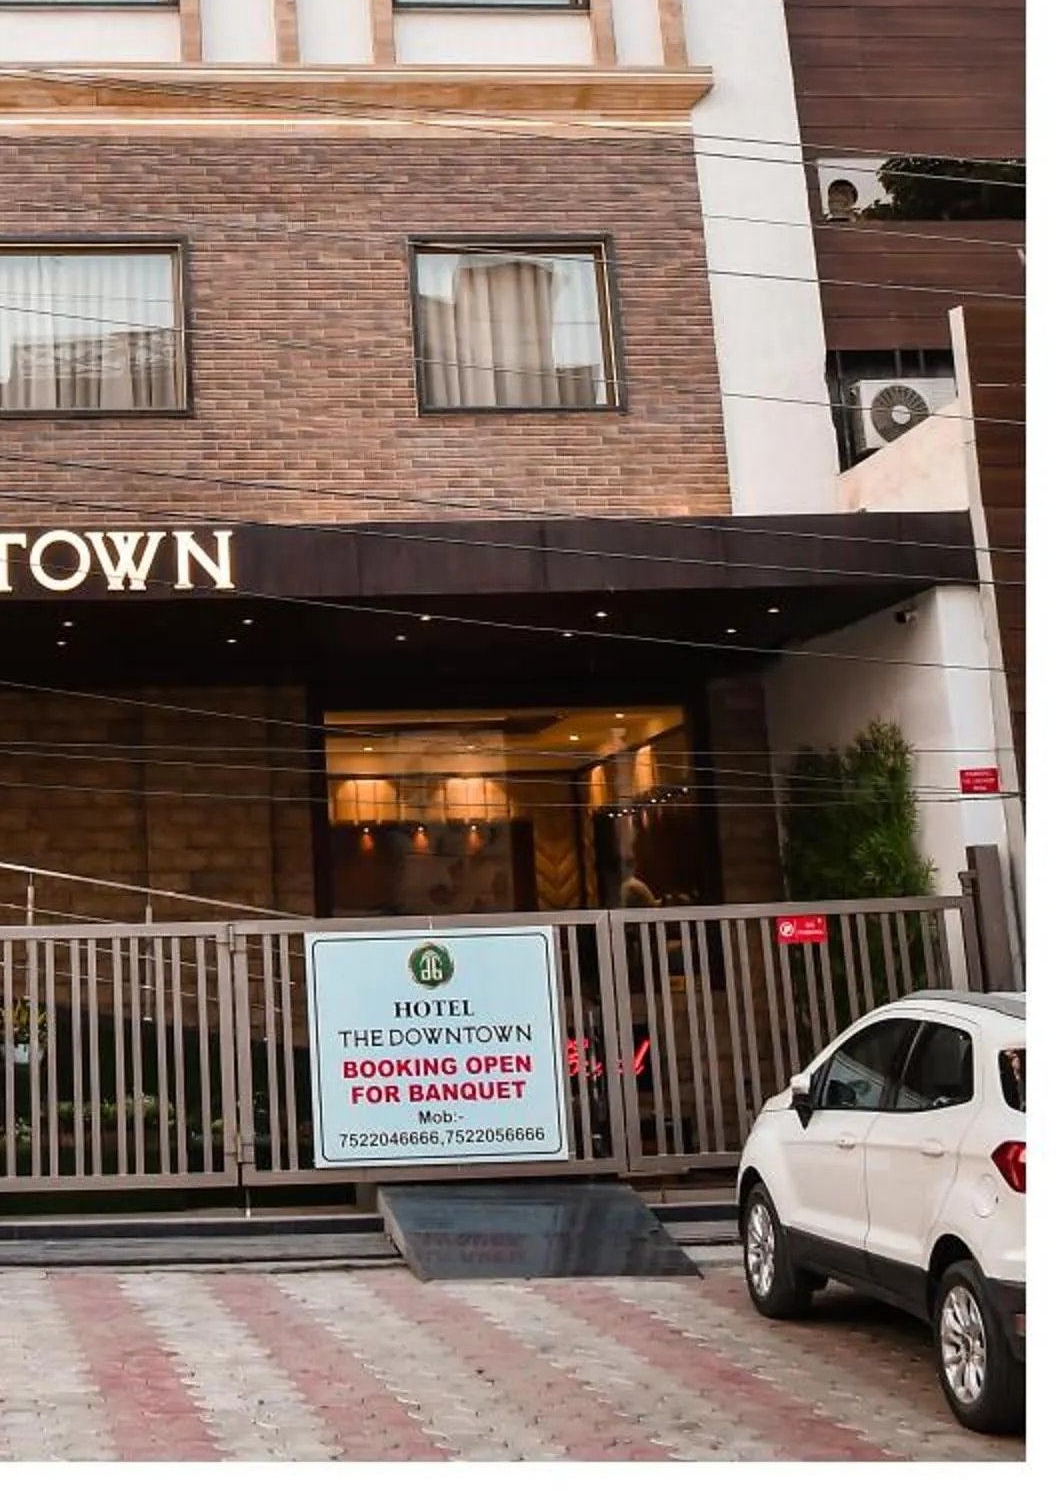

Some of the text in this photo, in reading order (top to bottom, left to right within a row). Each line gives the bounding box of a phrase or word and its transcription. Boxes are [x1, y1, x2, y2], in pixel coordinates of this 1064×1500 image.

[393, 1000, 475, 1018] HOTEL
[338, 1024, 533, 1048] THE DOWNTOWN
[343, 1054, 532, 1079] BOOKING OPEN
[351, 1080, 527, 1104] FOR BANQUET
[418, 1110, 465, 1125] Mob:-
